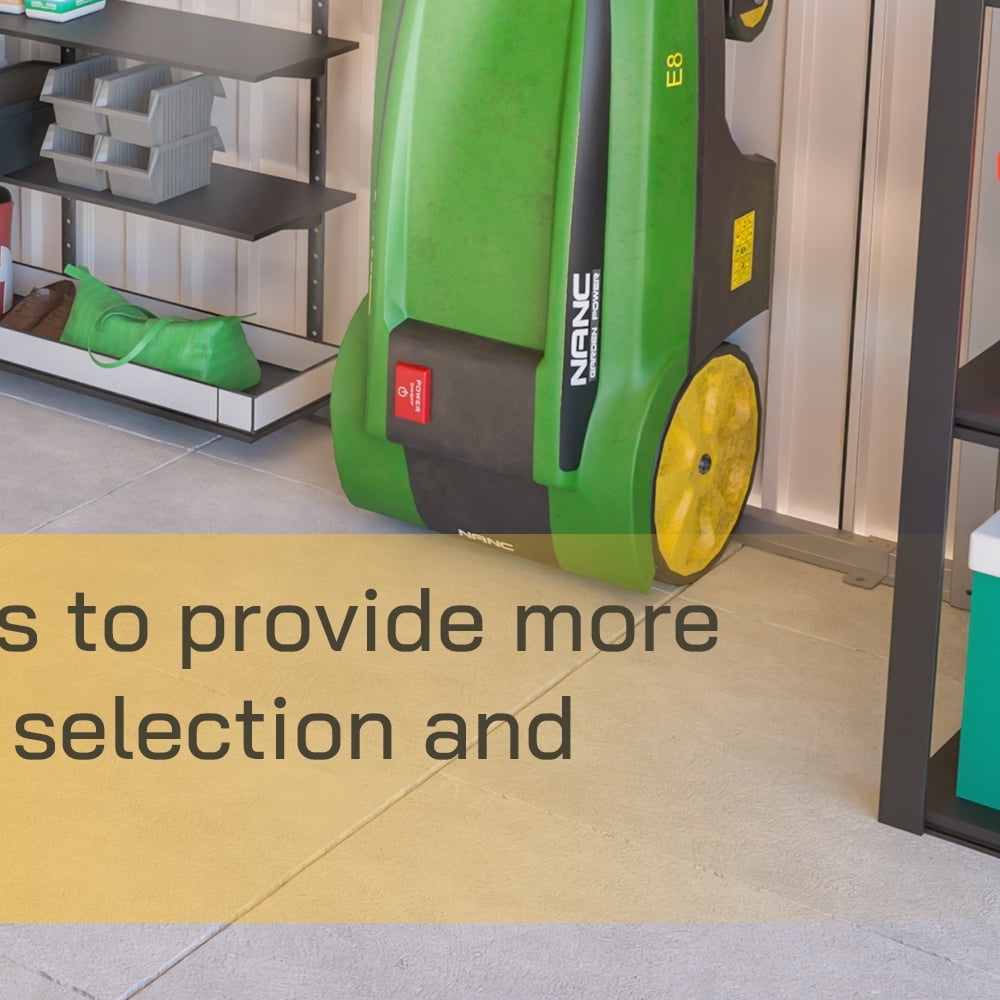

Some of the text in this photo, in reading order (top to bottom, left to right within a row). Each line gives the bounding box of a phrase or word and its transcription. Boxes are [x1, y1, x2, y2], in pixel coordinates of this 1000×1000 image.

[666, 52, 682, 87] E8
[570, 273, 590, 386] NANC
[589, 272, 600, 378] GARDEN POWER
[457, 528, 514, 552] NANC
